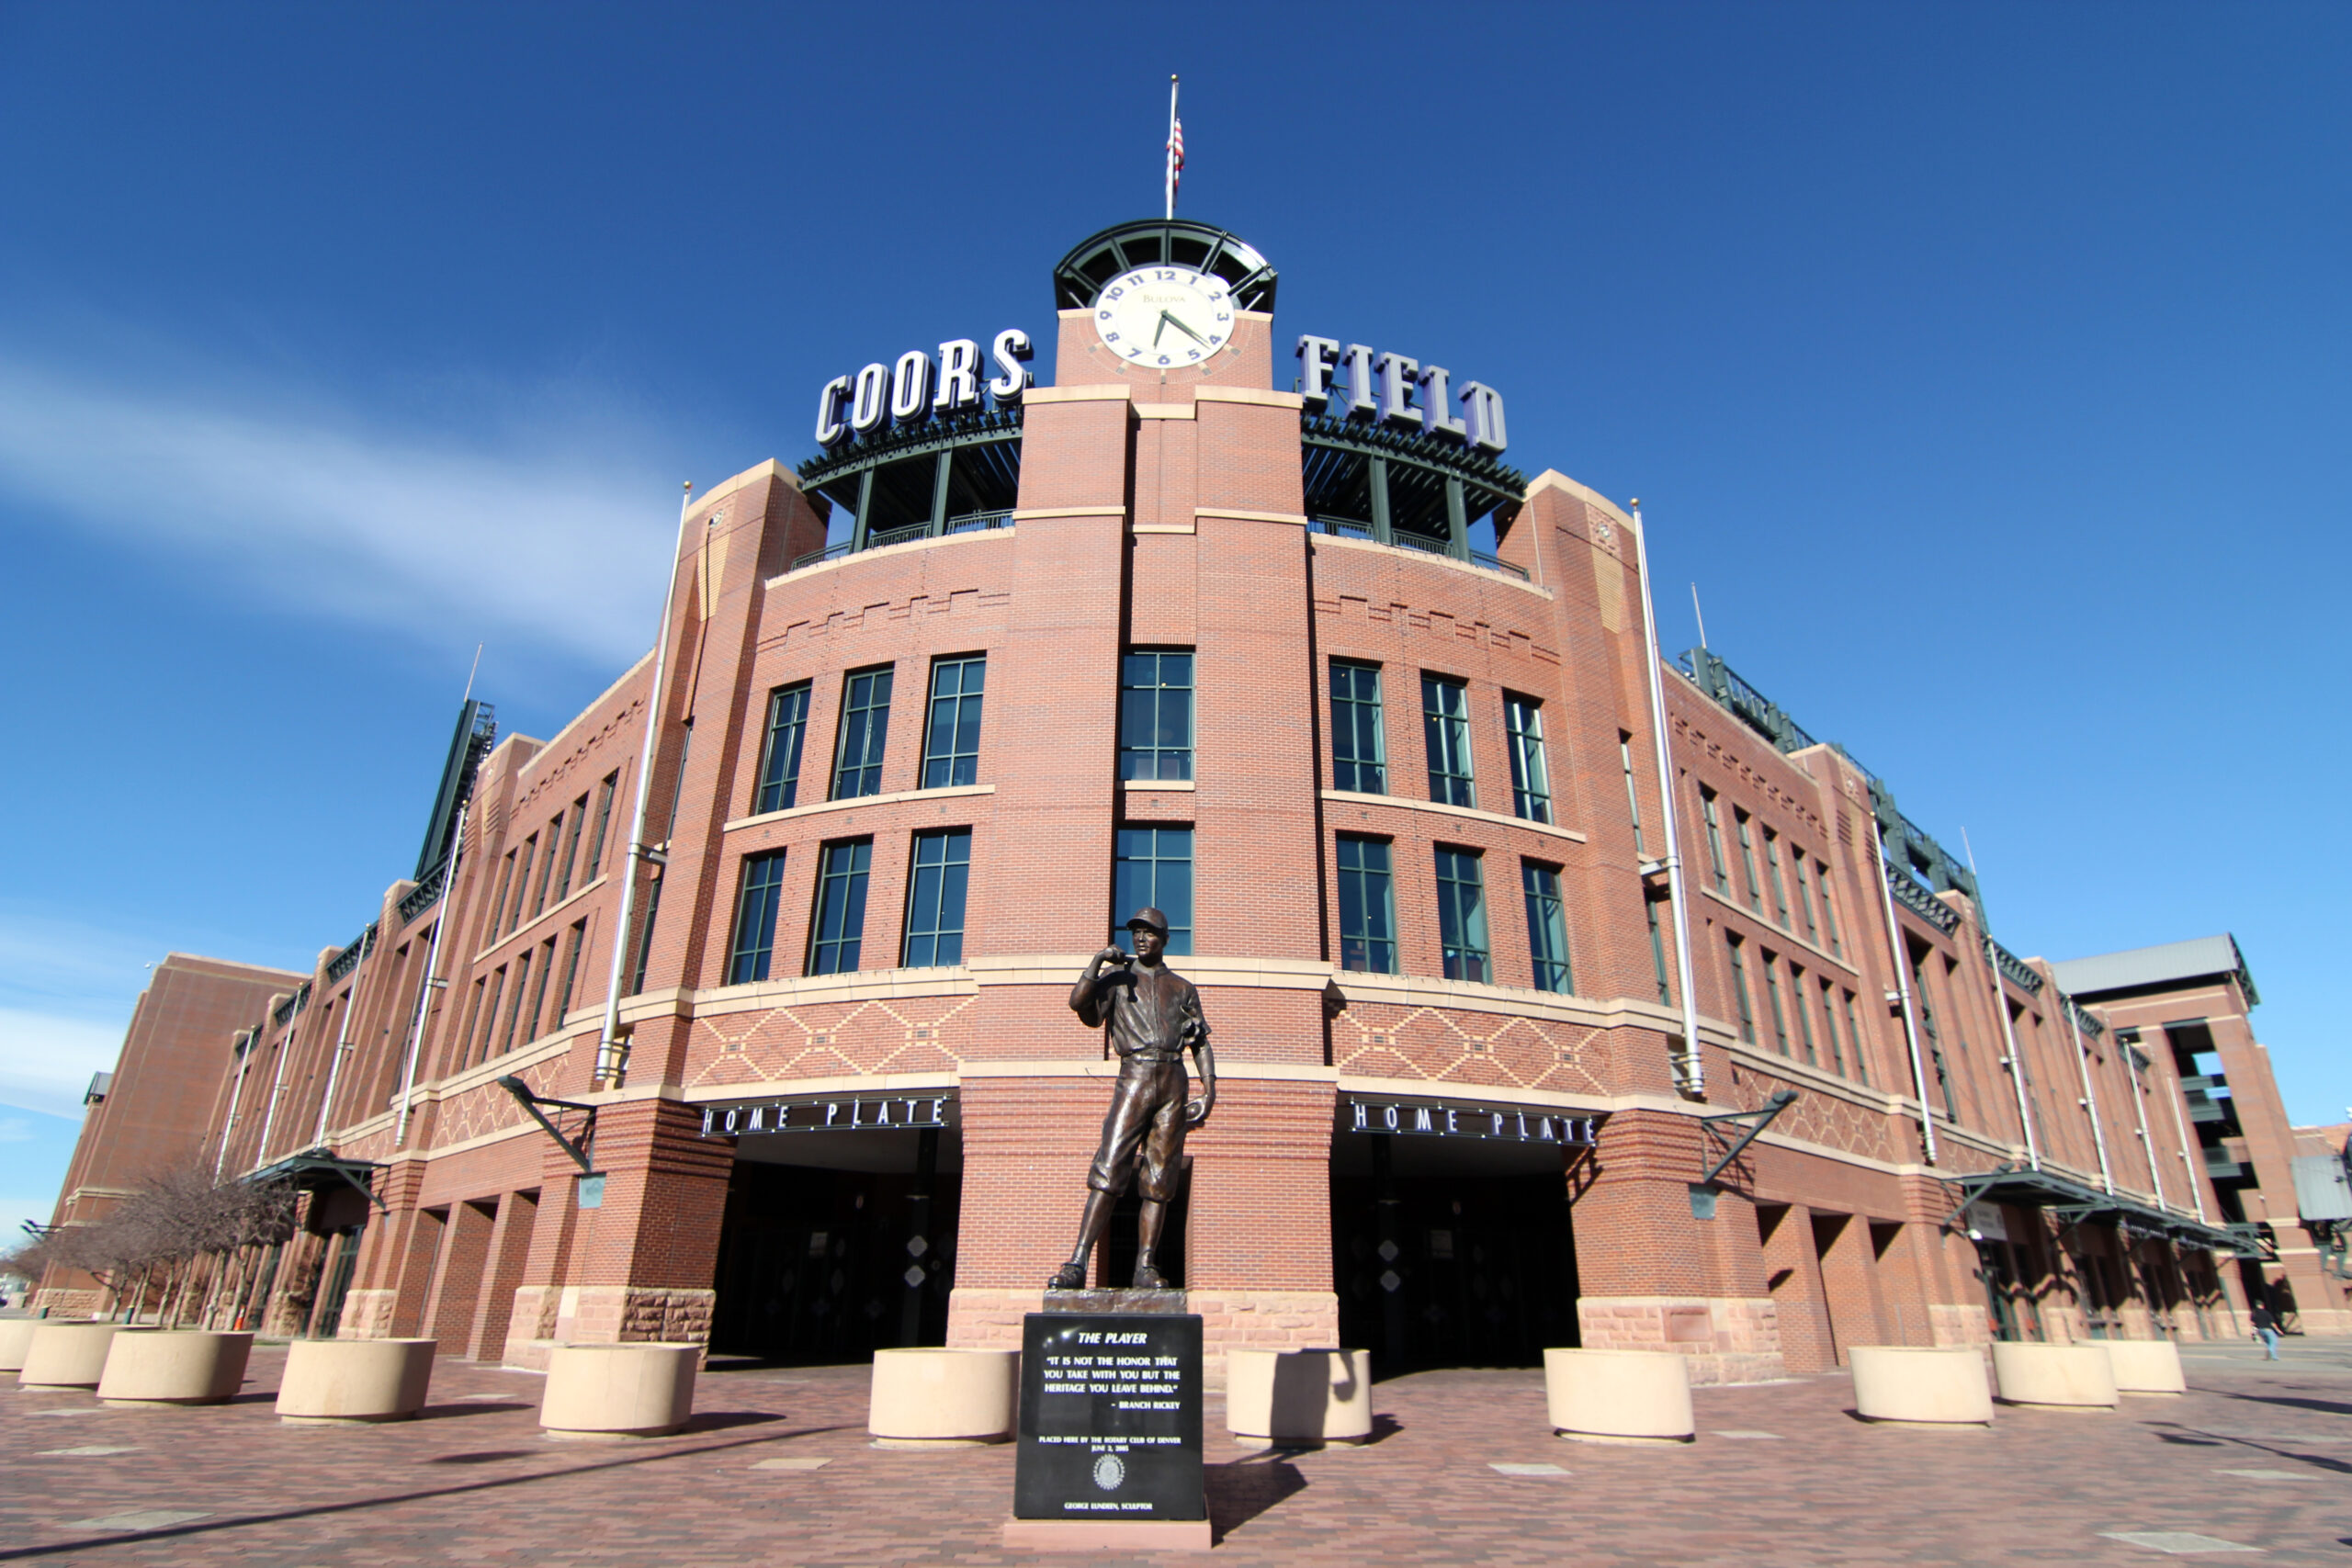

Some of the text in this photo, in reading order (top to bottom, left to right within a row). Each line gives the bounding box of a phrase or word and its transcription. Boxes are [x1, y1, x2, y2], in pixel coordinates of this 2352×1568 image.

[1126, 274, 1145, 287] 11
[1154, 270, 1176, 280] 12
[1189, 276, 1198, 285] 1
[1105, 287, 1125, 301] 10
[1142, 294, 1187, 304] BULOVA
[1207, 291, 1223, 302] 2
[1099, 310, 1113, 321] 9
[1216, 312, 1229, 321] 3
[1105, 332, 1120, 343] 8
[1208, 334, 1222, 345] 4
[1126, 348, 1143, 358] 7
[1187, 349, 1201, 360] 5
[1157, 355, 1171, 366] 6
[815, 328, 1508, 453] COORS FIELD
[702, 1099, 944, 1133] HOME PLATE
[1353, 1103, 1596, 1143] HOME PLATE
[1078, 1332, 1148, 1345] THE PLAYER
[1061, 1356, 1071, 1366] IS
[1073, 1356, 1094, 1366] NOT
[1096, 1356, 1114, 1366] THE
[1115, 1356, 1151, 1367] HONOR
[1154, 1356, 1179, 1367] THAT
[1043, 1369, 1181, 1381] YOU TAKE WITH YOU BUT THE
[1044, 1382, 1086, 1393] HERITAGE
[1089, 1382, 1109, 1393] YOU
[1111, 1382, 1137, 1393] LEAVE
[1118, 1400, 1152, 1410] BRANCH
[1152, 1401, 1181, 1410] RICKEY
[1038, 1435, 1182, 1444] PLACED HERE BY THE ROTARY CLUB OF DENVER
[1063, 1501, 1090, 1510] GEORGE
[1120, 1502, 1153, 1510] SCULPTOR
